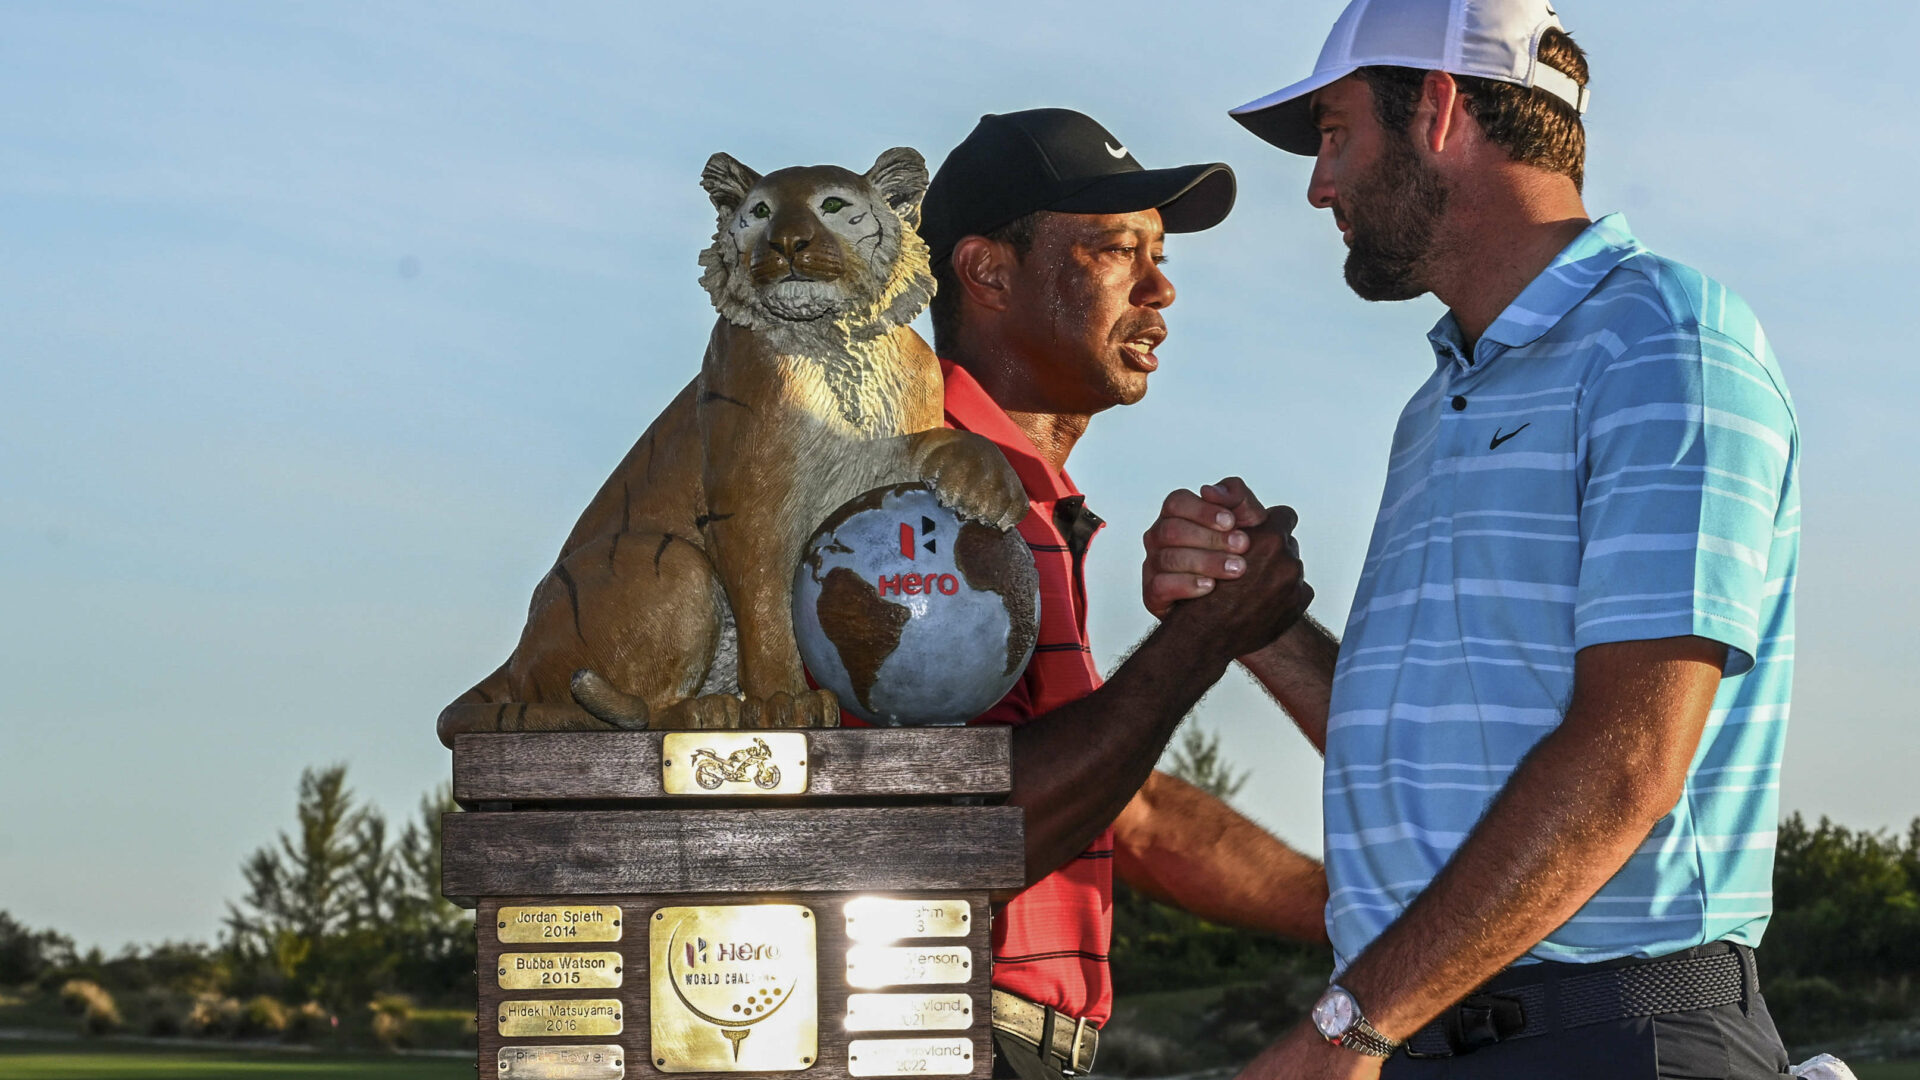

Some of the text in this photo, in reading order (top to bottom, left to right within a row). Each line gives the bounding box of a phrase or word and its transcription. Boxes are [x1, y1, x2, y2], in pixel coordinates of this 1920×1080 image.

[878, 572, 960, 597] Hero
[517, 911, 603, 924] Jordan Spieth
[544, 926, 577, 938] 2014
[717, 942, 781, 962] Hero
[517, 957, 606, 970] Bubba Watson
[542, 972, 581, 984] 2015
[685, 973, 720, 985] WORLD
[508, 1005, 614, 1018] Hideki Matsuyama
[546, 1020, 577, 1032] 2016
